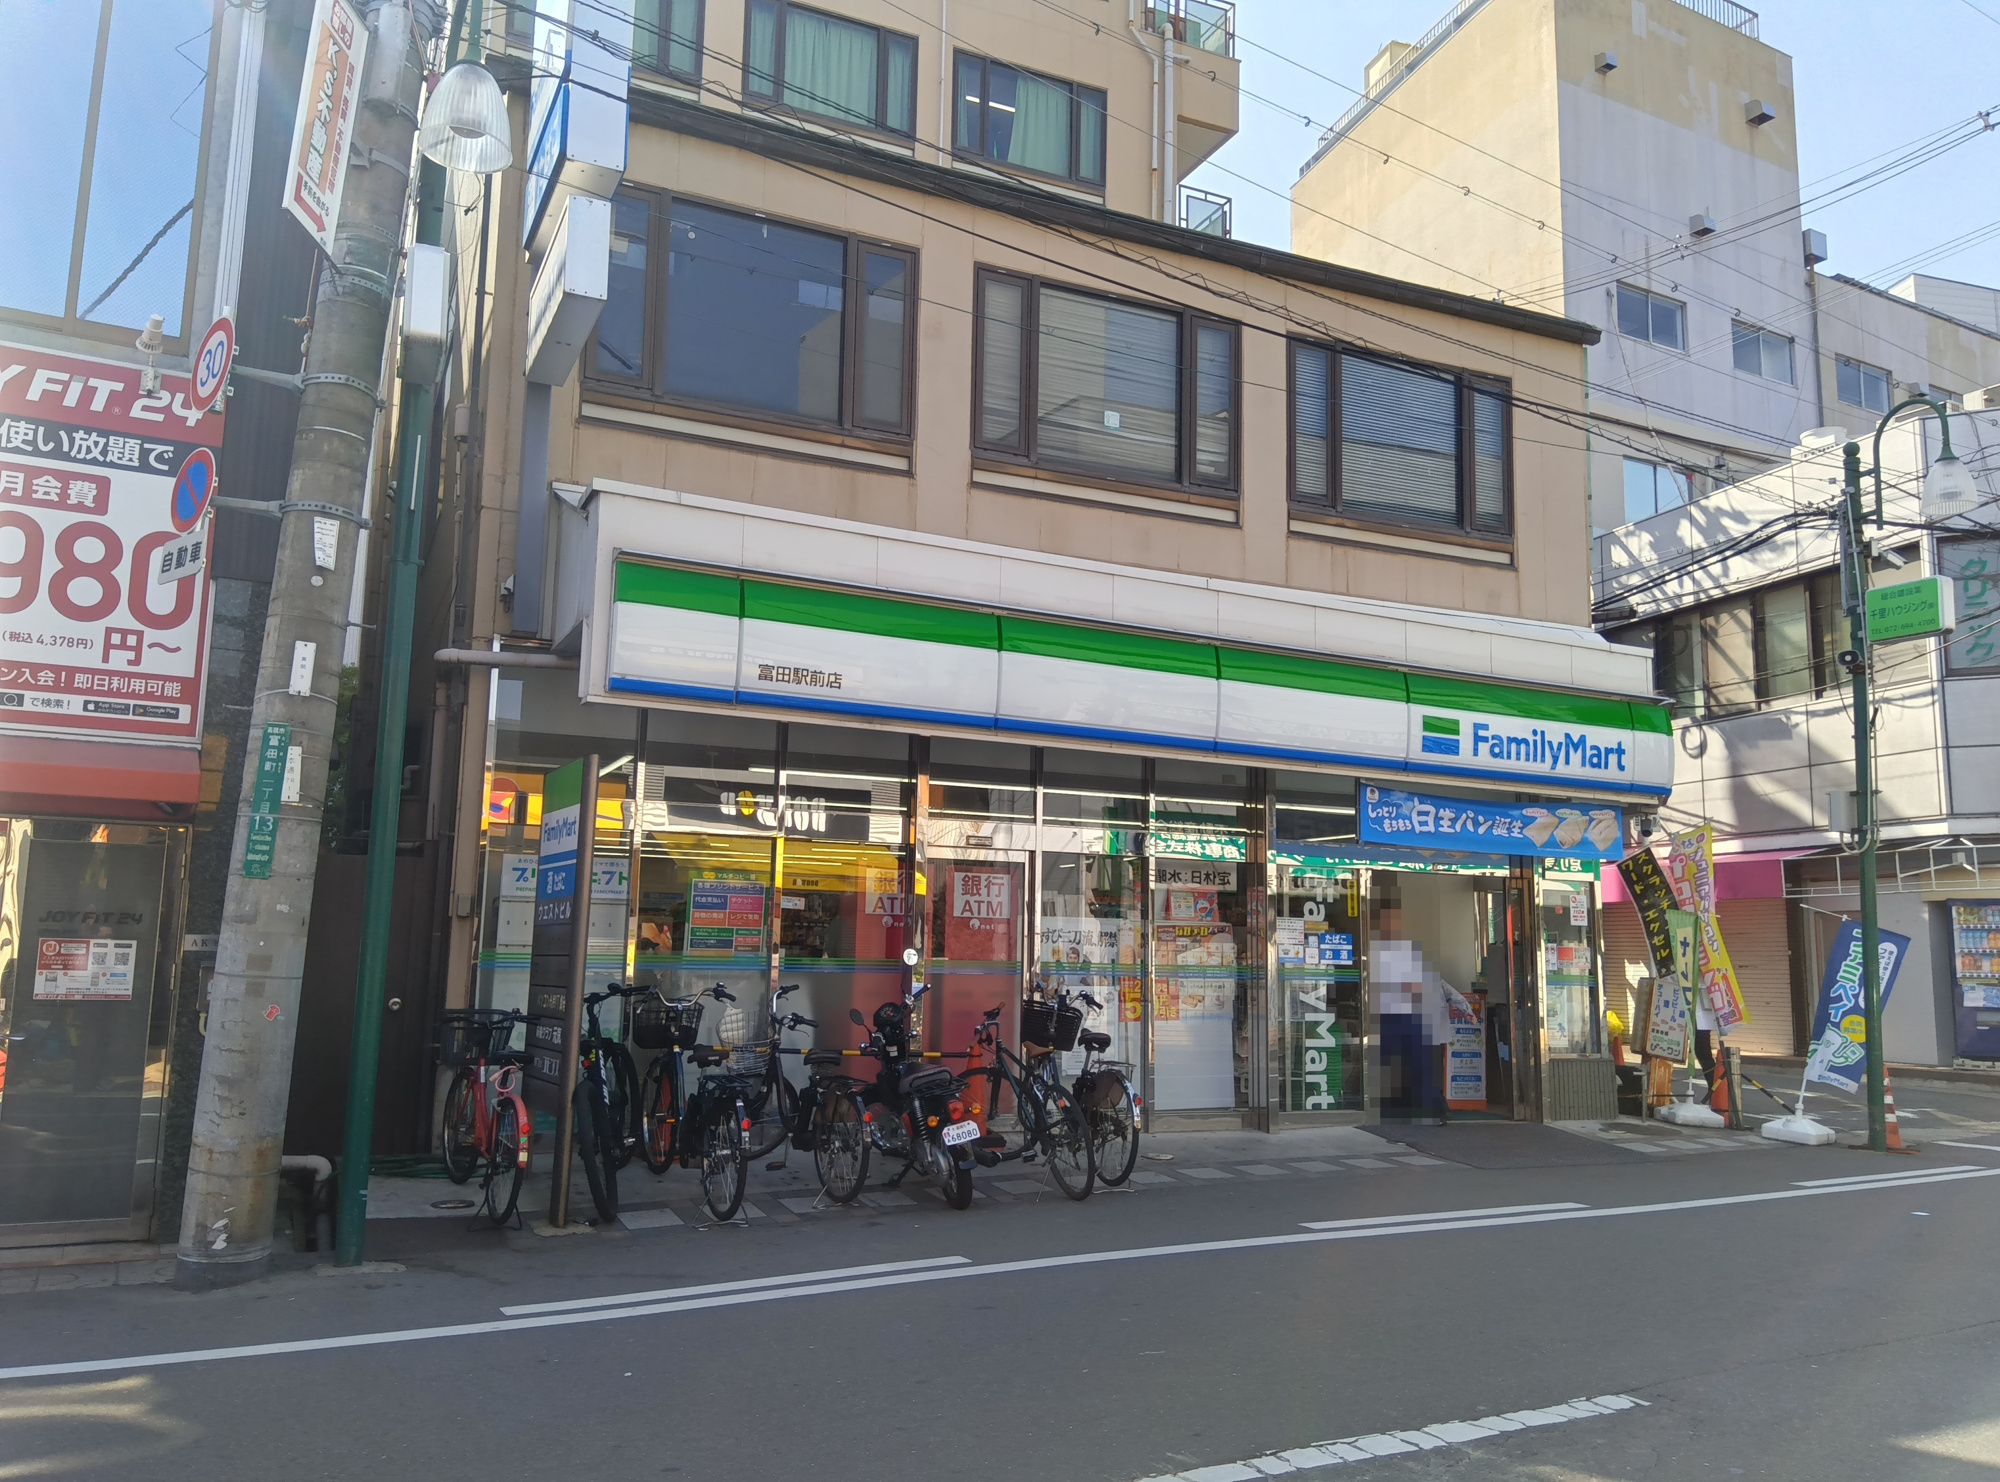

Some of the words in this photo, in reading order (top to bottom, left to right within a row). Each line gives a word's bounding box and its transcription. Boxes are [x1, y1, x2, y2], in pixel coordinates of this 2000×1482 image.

[199, 341, 224, 388] 30
[129, 389, 205, 427] 24
[0, 418, 174, 471] 使い放題で
[0, 470, 98, 508] 月会費
[161, 541, 203, 574] 自動車
[757, 663, 843, 690] 富田駅前店
[30, 696, 71, 710] で検索！
[147, 706, 165, 714] Google
[166, 708, 177, 716] Play
[1473, 722, 1626, 772] FamilyMart
[1368, 804, 1397, 817] しっとり
[254, 815, 274, 831] 13
[543, 816, 577, 845] FamilyMart
[1383, 818, 1412, 833] もちもち
[961, 874, 1005, 898] 銀行
[38, 910, 81, 923] JOY
[115, 912, 144, 925] 24
[960, 899, 1003, 917] ATM
[1325, 933, 1347, 944] たばこ
